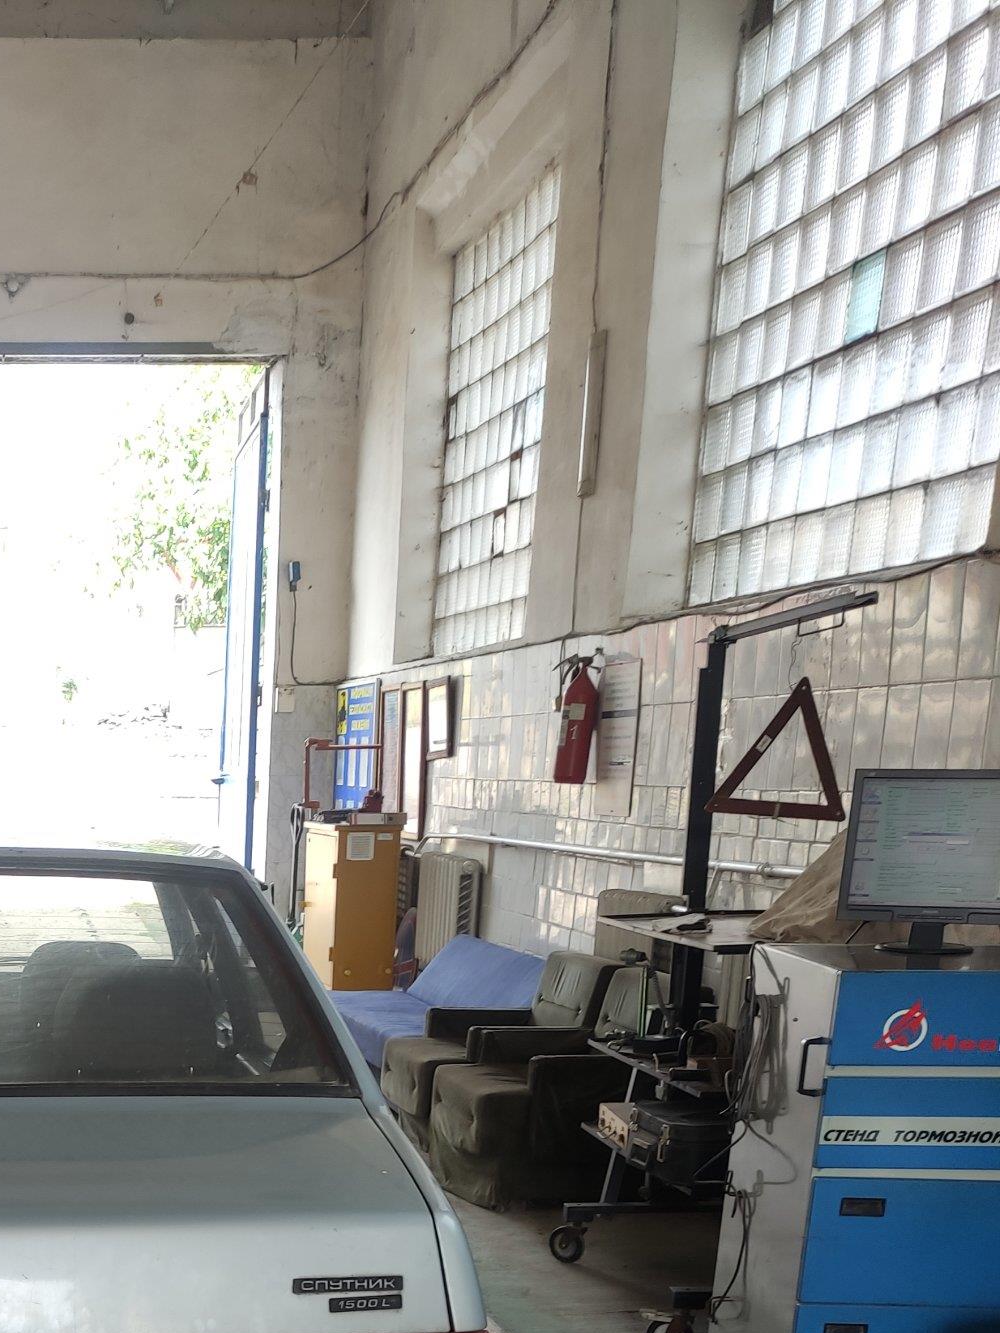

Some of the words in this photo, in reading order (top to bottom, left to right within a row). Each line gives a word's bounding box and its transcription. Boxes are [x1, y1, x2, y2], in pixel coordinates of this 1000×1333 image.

[823, 1129, 880, 1142] СТЕНД
[300, 1278, 396, 1291] СПУТНИК
[338, 1298, 379, 1309] 1500
[381, 1298, 391, 1307] L
